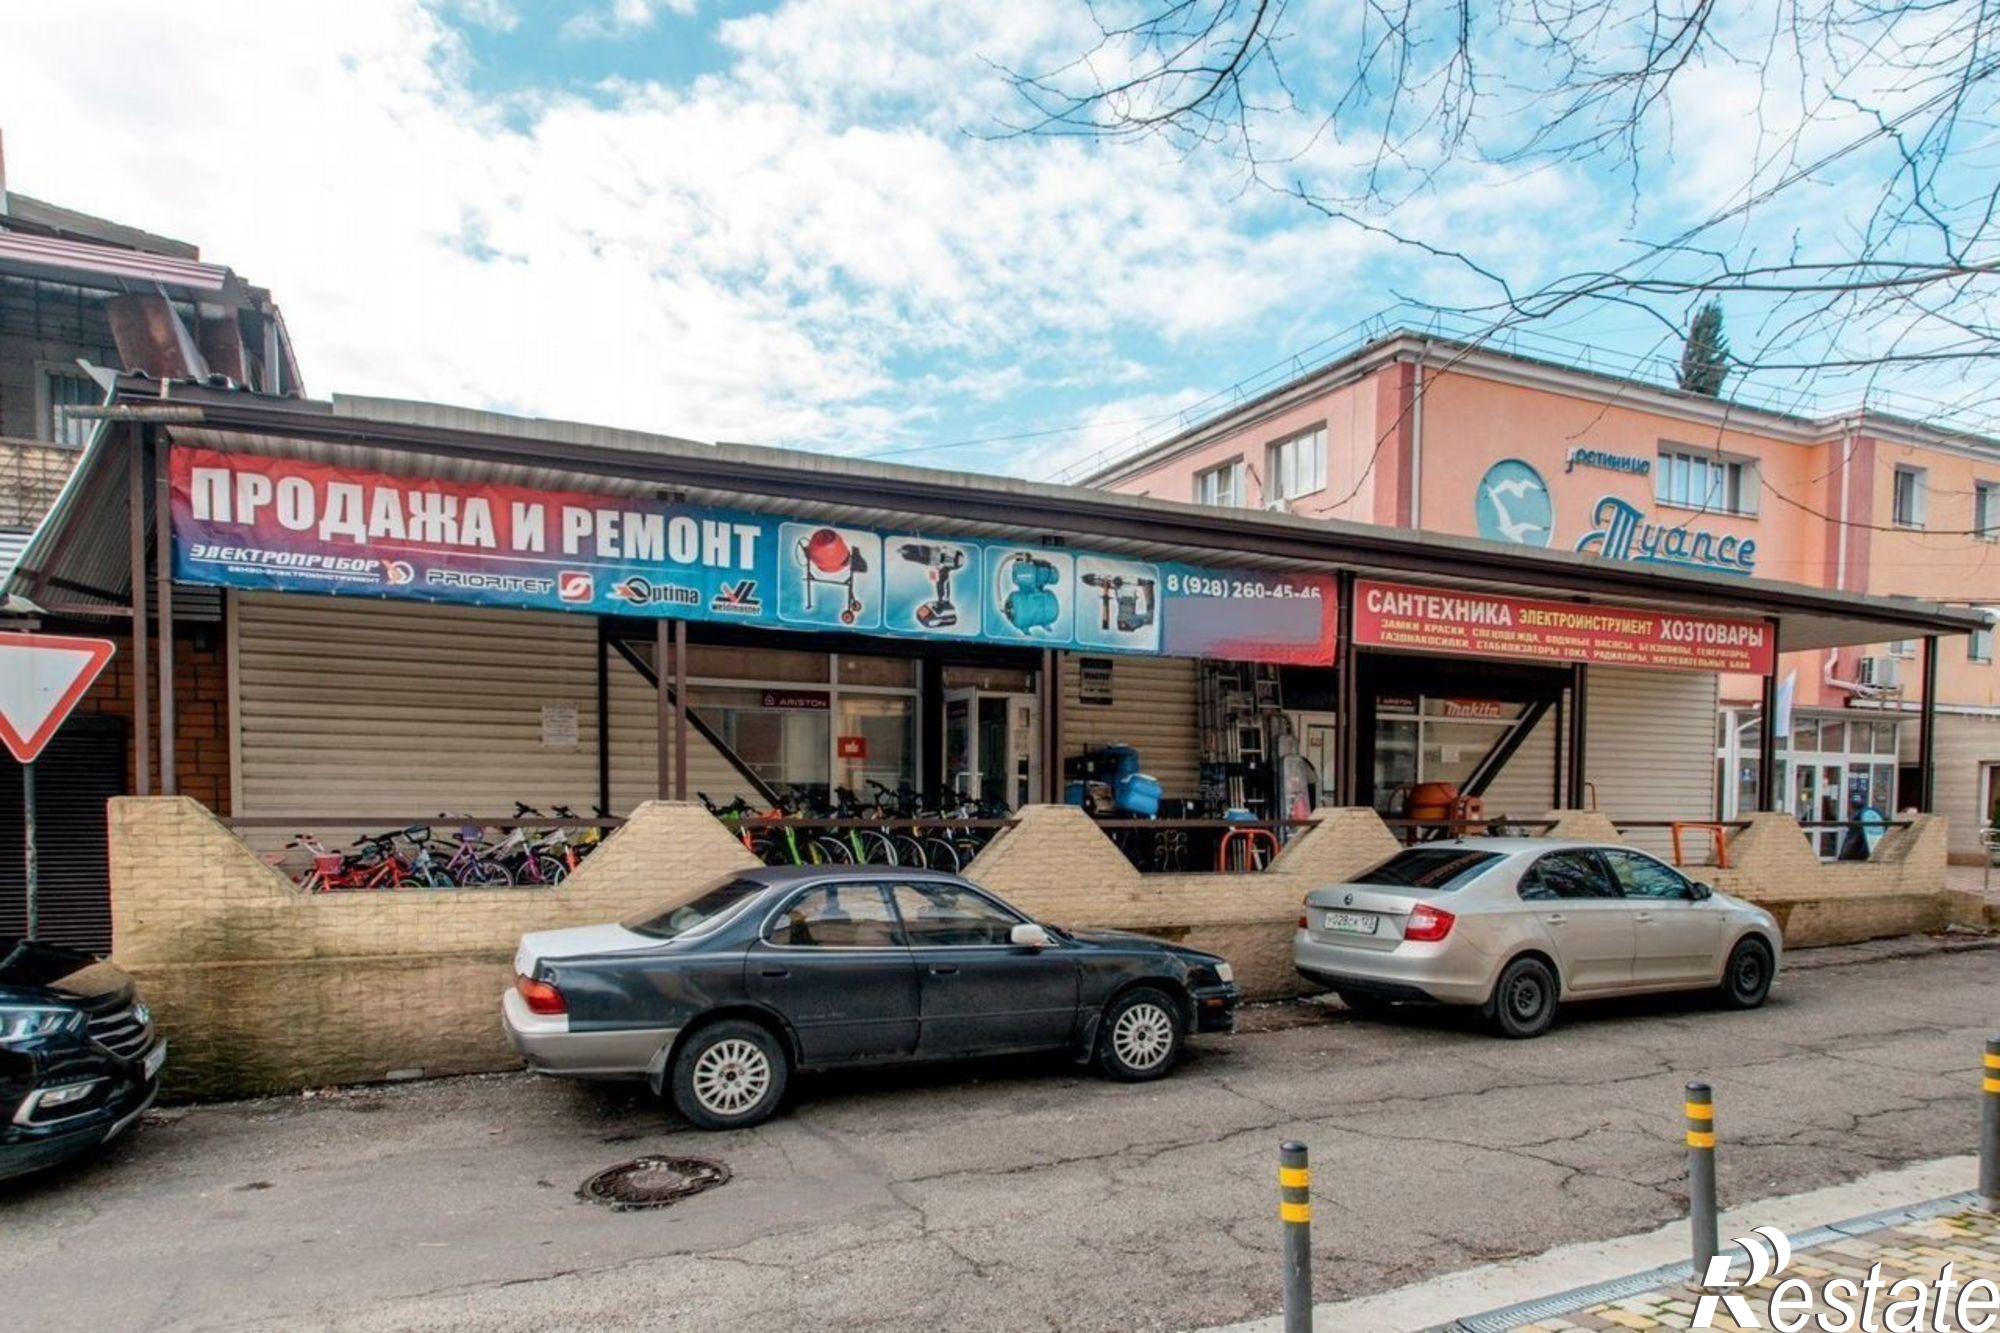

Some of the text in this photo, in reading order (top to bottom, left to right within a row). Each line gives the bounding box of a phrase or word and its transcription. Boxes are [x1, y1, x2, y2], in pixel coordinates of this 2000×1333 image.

[191, 467, 761, 571] ПРОДАЖА И РЕМОНТ
[426, 571, 554, 595] PRIORITET
[1167, 574, 1322, 599] 8 (928) 260-45-46
[1367, 589, 1763, 647] САНТЕХНИКА ЭЛЕКТРОИНСТРУМЕНТ ХОЗТОВАРЫ
[779, 698, 828, 707] ARISTON
